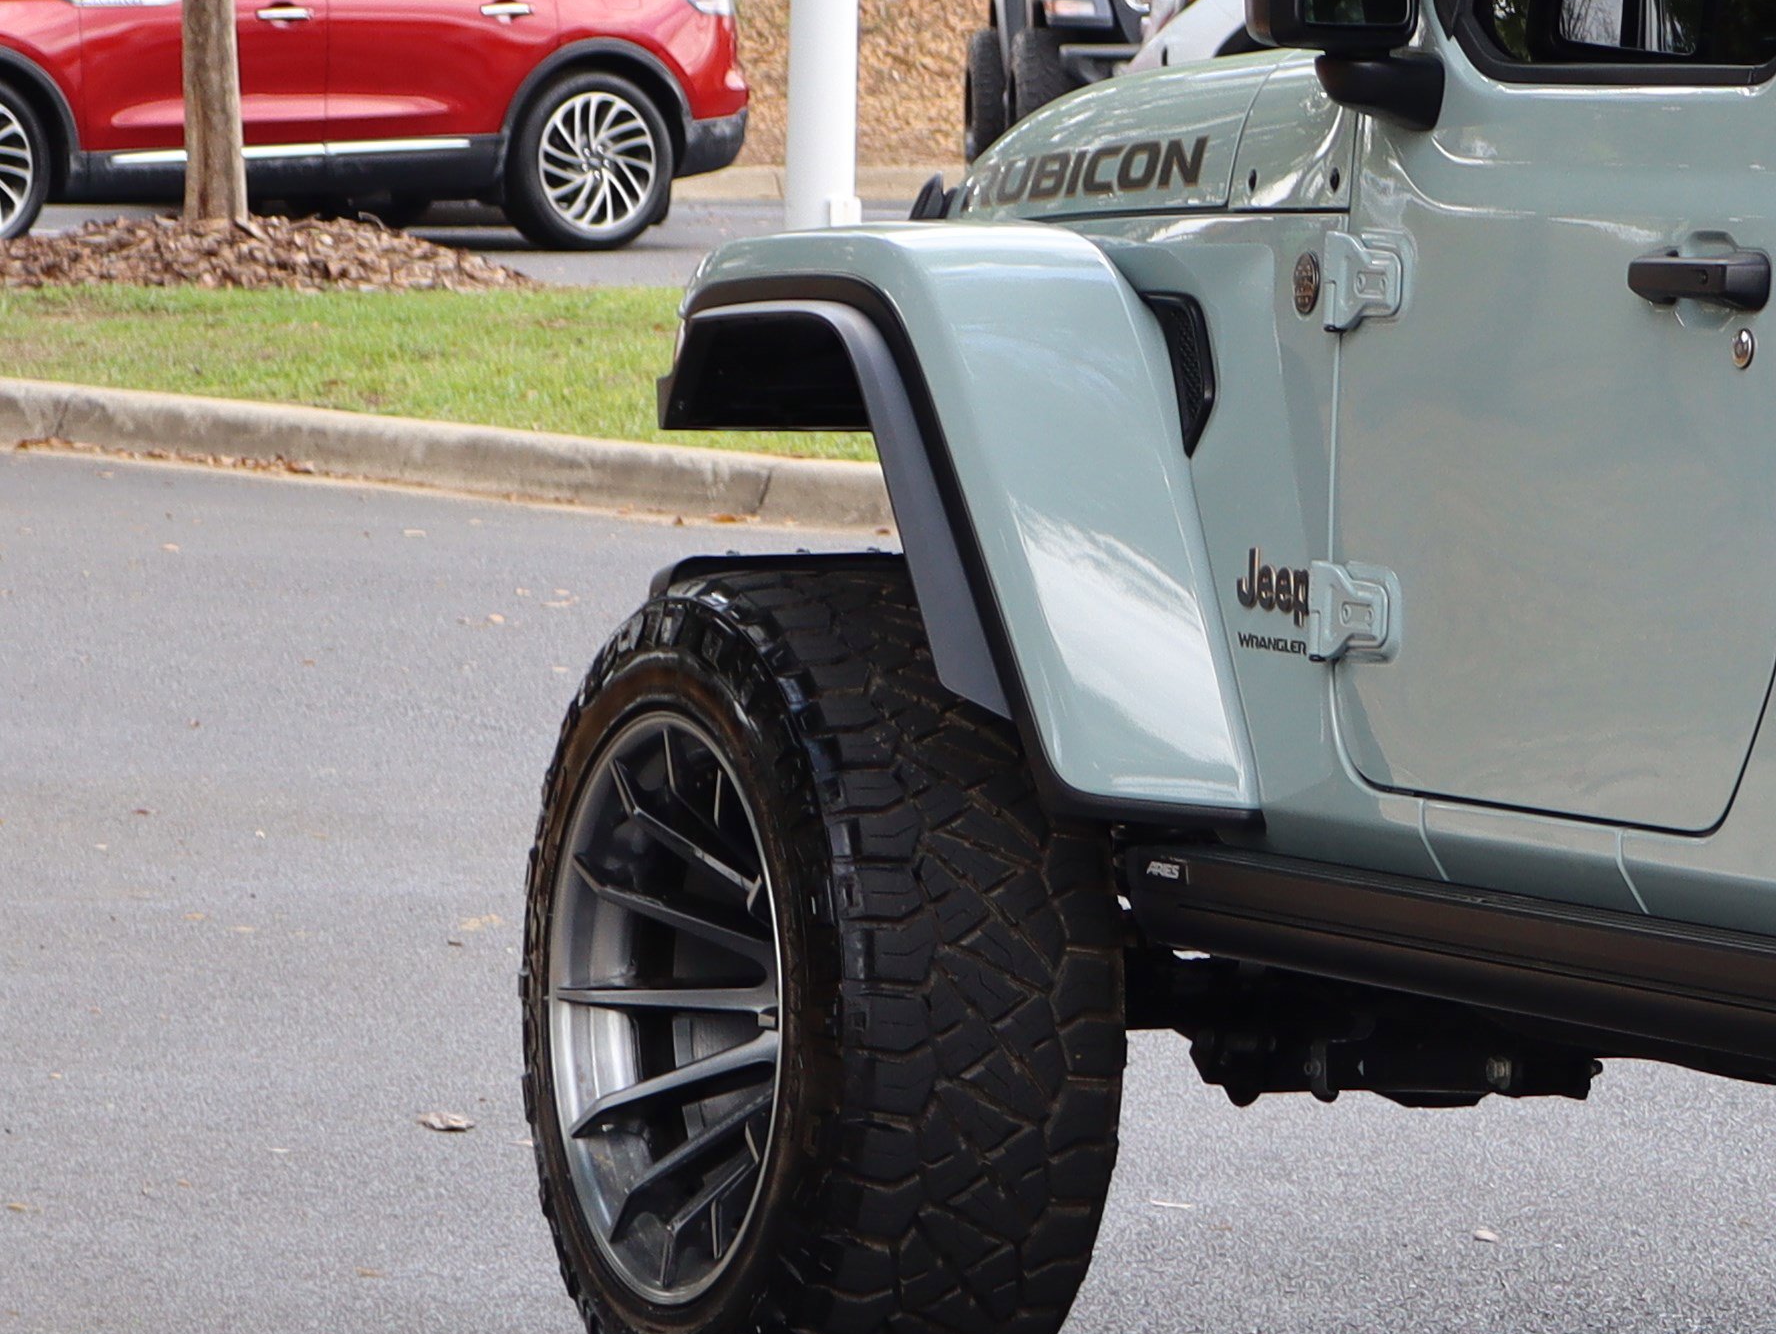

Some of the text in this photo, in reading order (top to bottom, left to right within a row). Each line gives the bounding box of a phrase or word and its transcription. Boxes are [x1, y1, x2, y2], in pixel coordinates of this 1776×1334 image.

[1236, 547, 1310, 628] Jeep
[1237, 631, 1307, 656] WRANGLER
[1146, 860, 1180, 879] ARIES
